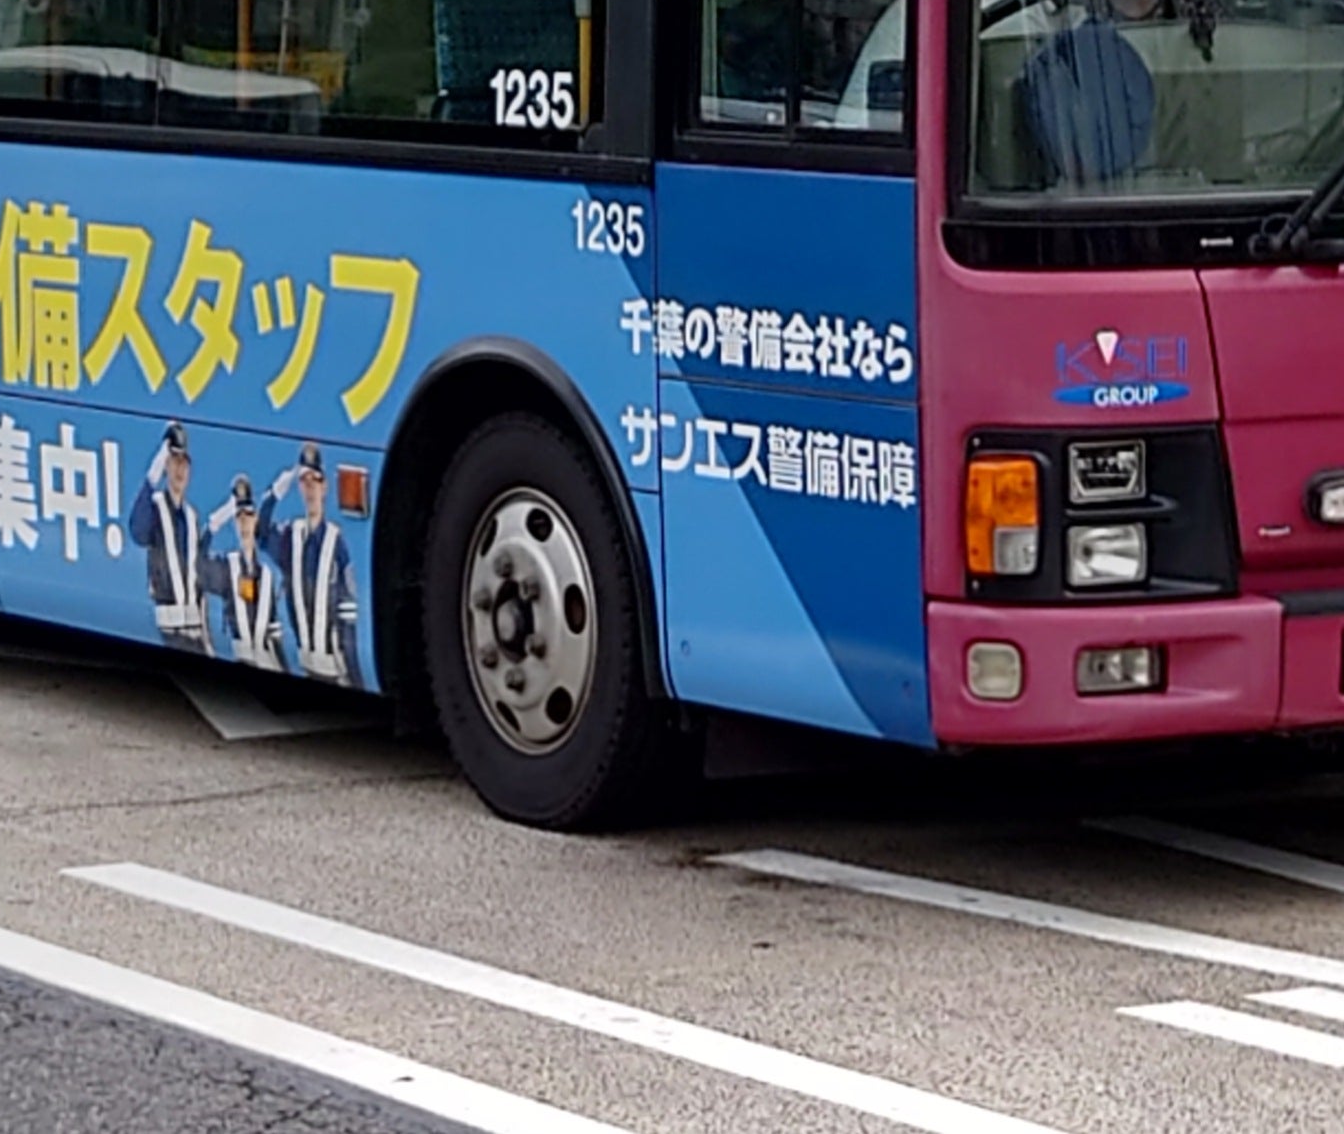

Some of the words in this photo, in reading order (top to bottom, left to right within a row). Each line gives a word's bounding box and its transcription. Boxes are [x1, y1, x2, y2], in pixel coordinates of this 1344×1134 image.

[490, 69, 575, 129] 1235
[572, 199, 645, 257] 1235
[620, 297, 914, 384] 千葉の警備会社なら
[1093, 385, 1159, 408] GROUP
[620, 404, 916, 508] サンエス警備保障
